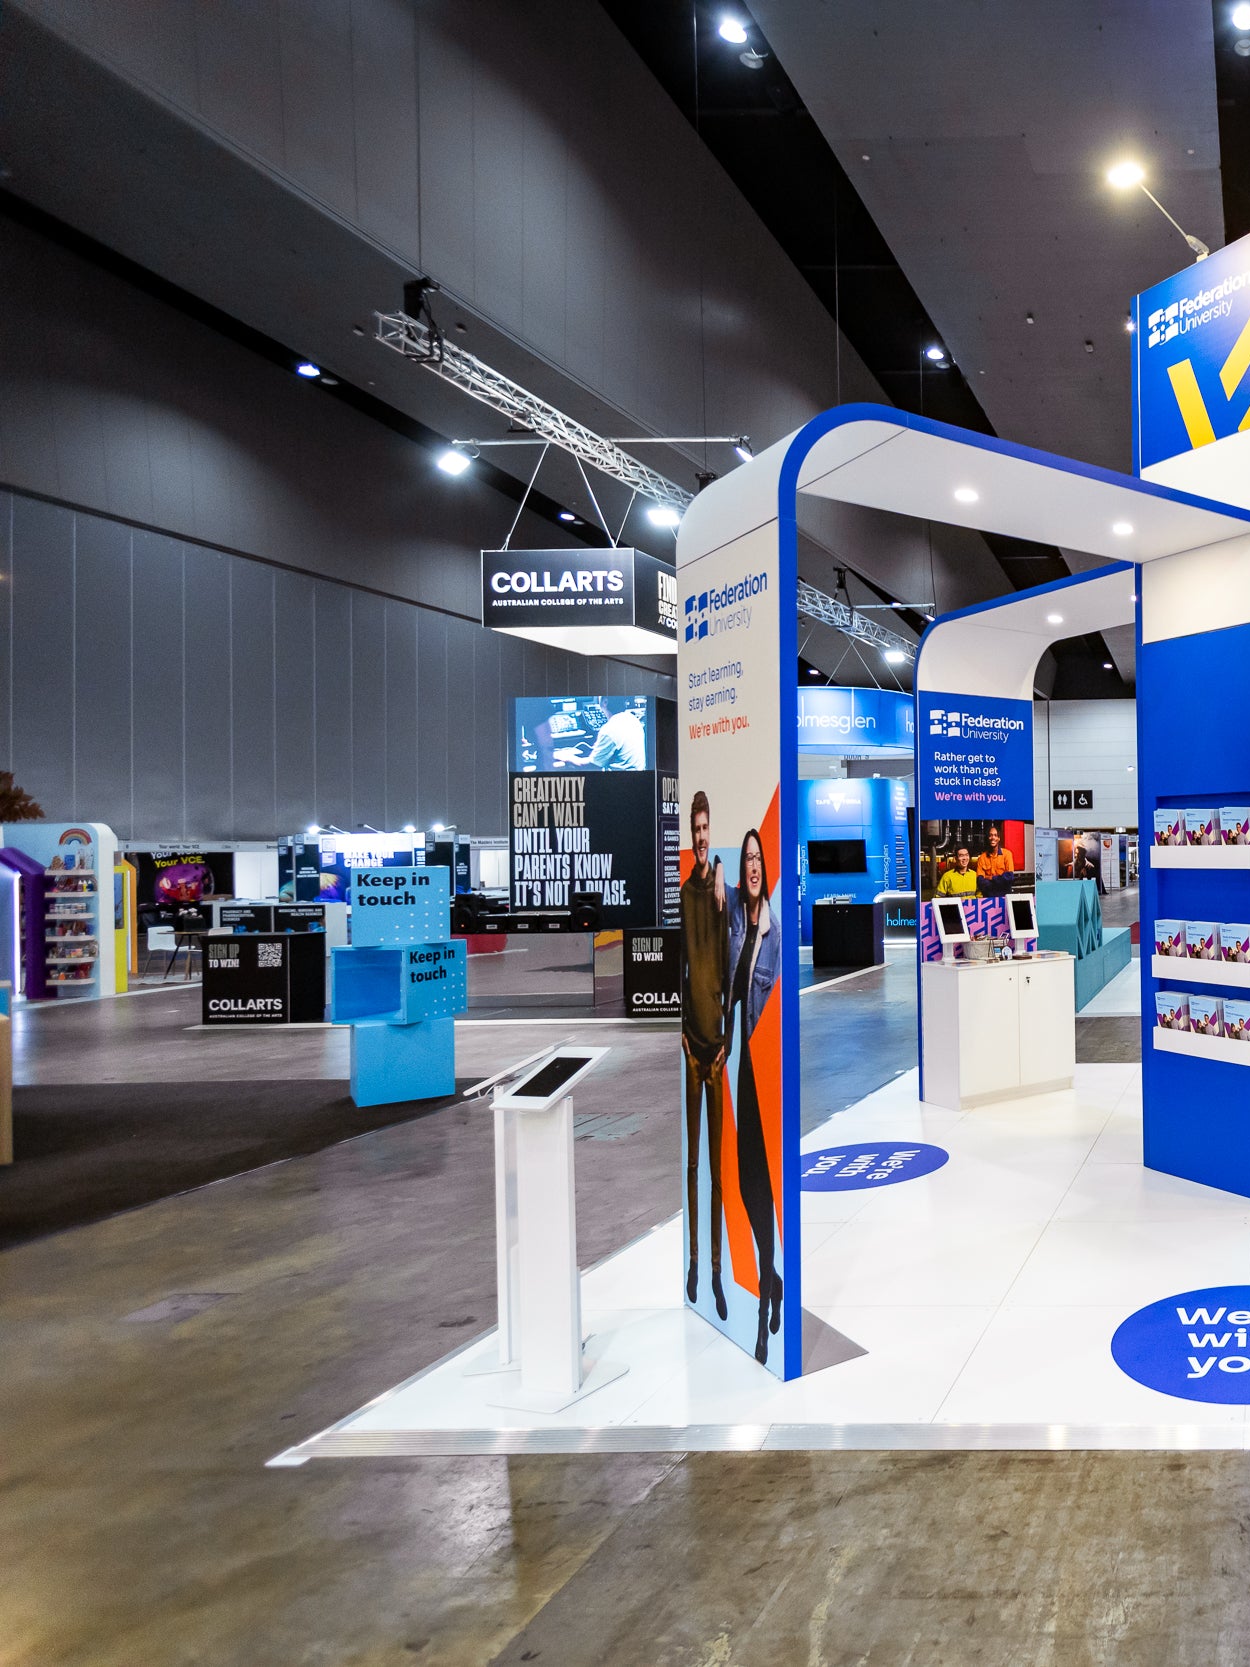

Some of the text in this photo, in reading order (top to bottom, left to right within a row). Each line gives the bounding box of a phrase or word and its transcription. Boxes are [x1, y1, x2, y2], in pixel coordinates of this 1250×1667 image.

[1179, 299, 1233, 335] University
[491, 570, 624, 593] COLLARTS
[541, 598, 575, 606] COLLEGE
[709, 572, 768, 614] Federation
[658, 616, 667, 625] AT
[709, 606, 753, 637] University
[688, 661, 744, 689] Start learning,
[688, 686, 738, 712] stay earning.
[689, 714, 750, 740] We're with you.
[961, 713, 1024, 731] Federation
[961, 728, 1009, 744] University
[934, 751, 996, 764] Rather get to
[934, 764, 998, 776] work than get
[513, 776, 586, 803] CREATIVITY
[934, 776, 1001, 787] stuck in class?
[934, 792, 1006, 803] We're with you.
[513, 802, 586, 828] CAN'T WAIT
[662, 802, 673, 815] SAT
[514, 827, 590, 854] UNTIL YOUR
[154, 856, 206, 869] Your VCE.
[344, 858, 384, 867] CHANGE
[514, 853, 613, 880] PARENTS KNOW
[357, 872, 430, 890] Keep in
[357, 891, 416, 907] touch
[514, 881, 542, 907] IT'S
[545, 881, 571, 906] NOT
[208, 943, 240, 959] SIGN UP
[632, 937, 663, 952] SIGN UP
[208, 959, 240, 968] TO WIN!
[409, 947, 455, 965] Keep in
[632, 952, 663, 962] TO WIN!
[410, 966, 447, 984] touch
[209, 998, 283, 1011] COLLARTS
[632, 992, 682, 1005] COLLA
[801, 1154, 846, 1178] you.
[834, 1153, 880, 1178] with
[865, 1149, 921, 1181] We're
